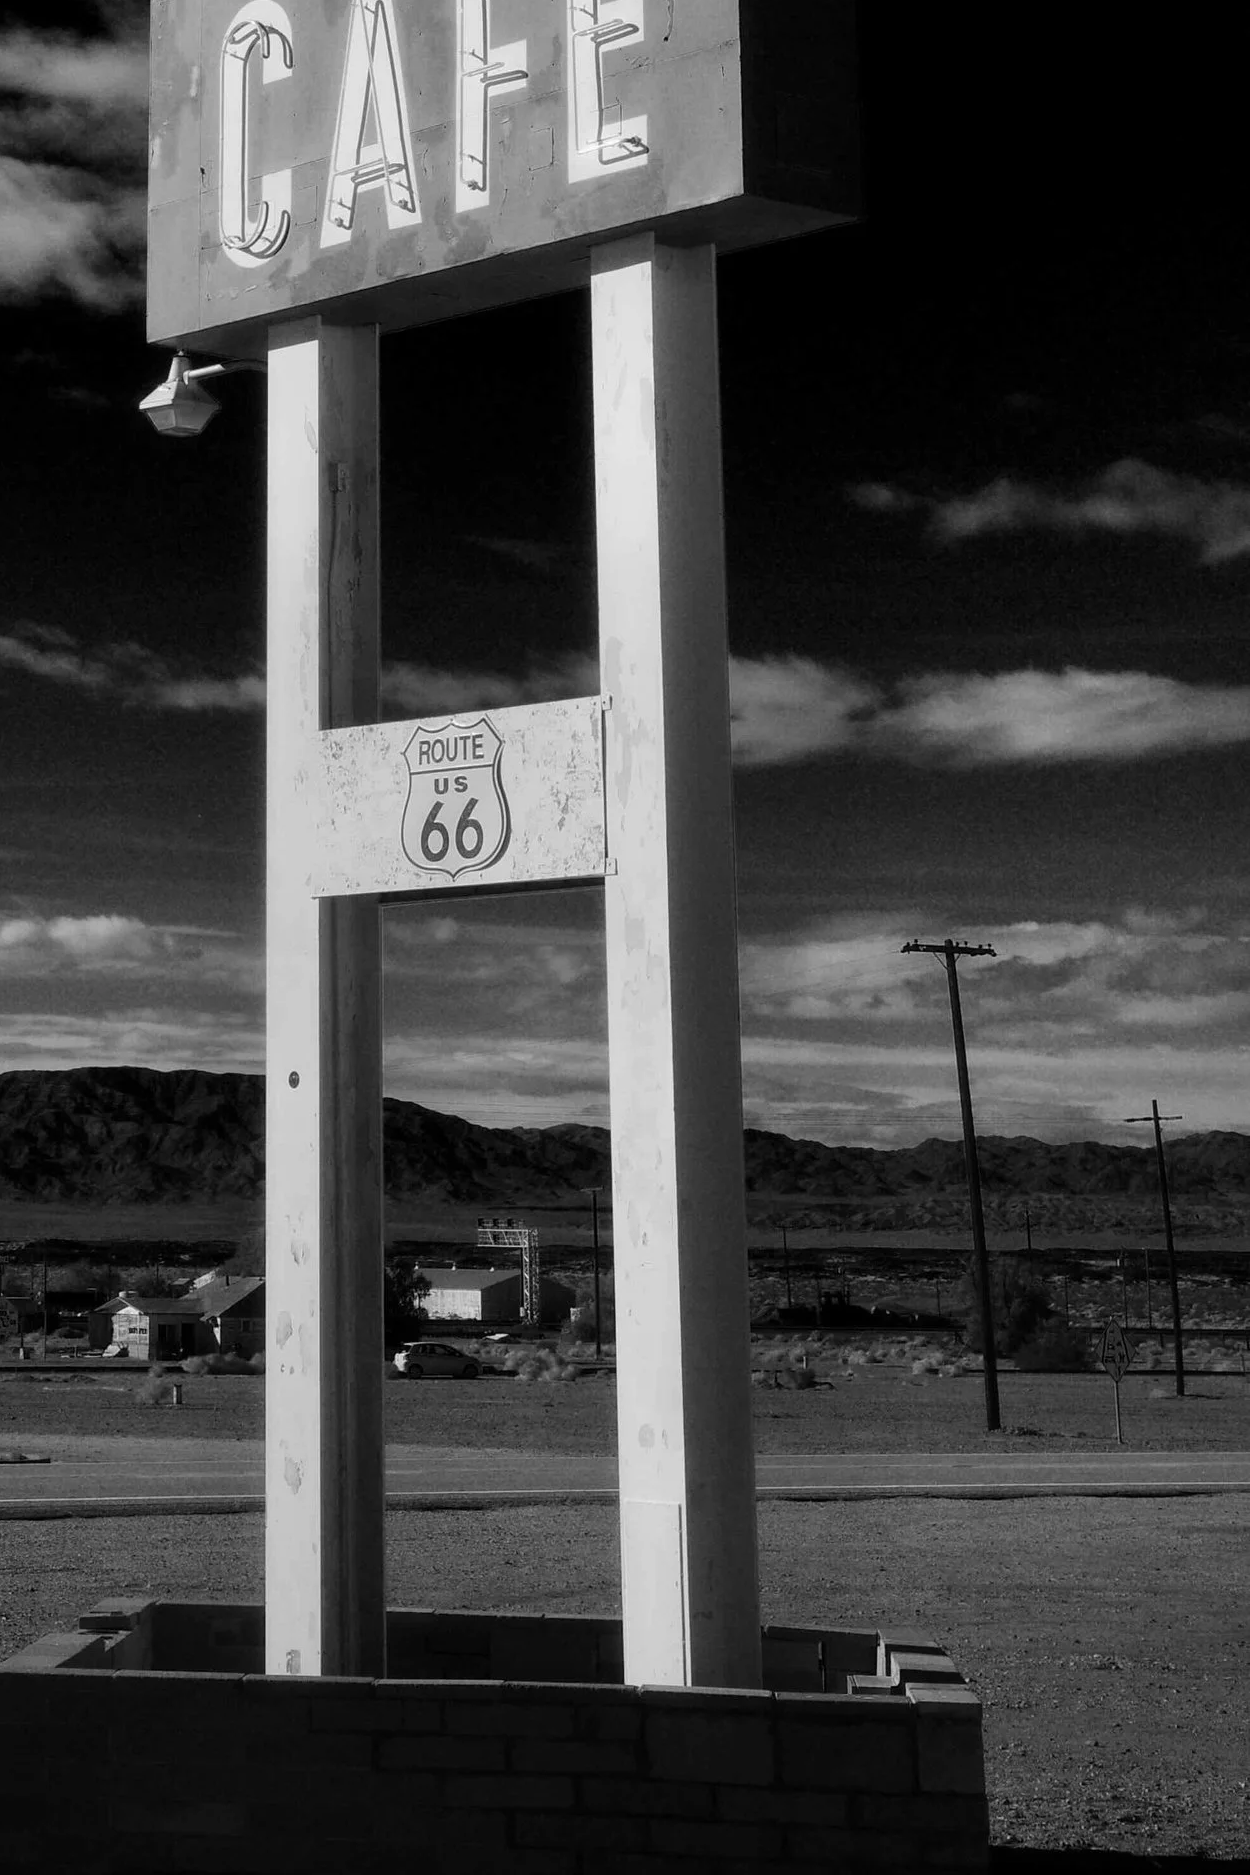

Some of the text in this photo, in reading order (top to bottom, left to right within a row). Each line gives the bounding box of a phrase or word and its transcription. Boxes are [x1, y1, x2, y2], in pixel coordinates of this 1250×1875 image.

[418, 733, 485, 765] ROUTE
[434, 776, 468, 795] US
[420, 797, 484, 862] 66
